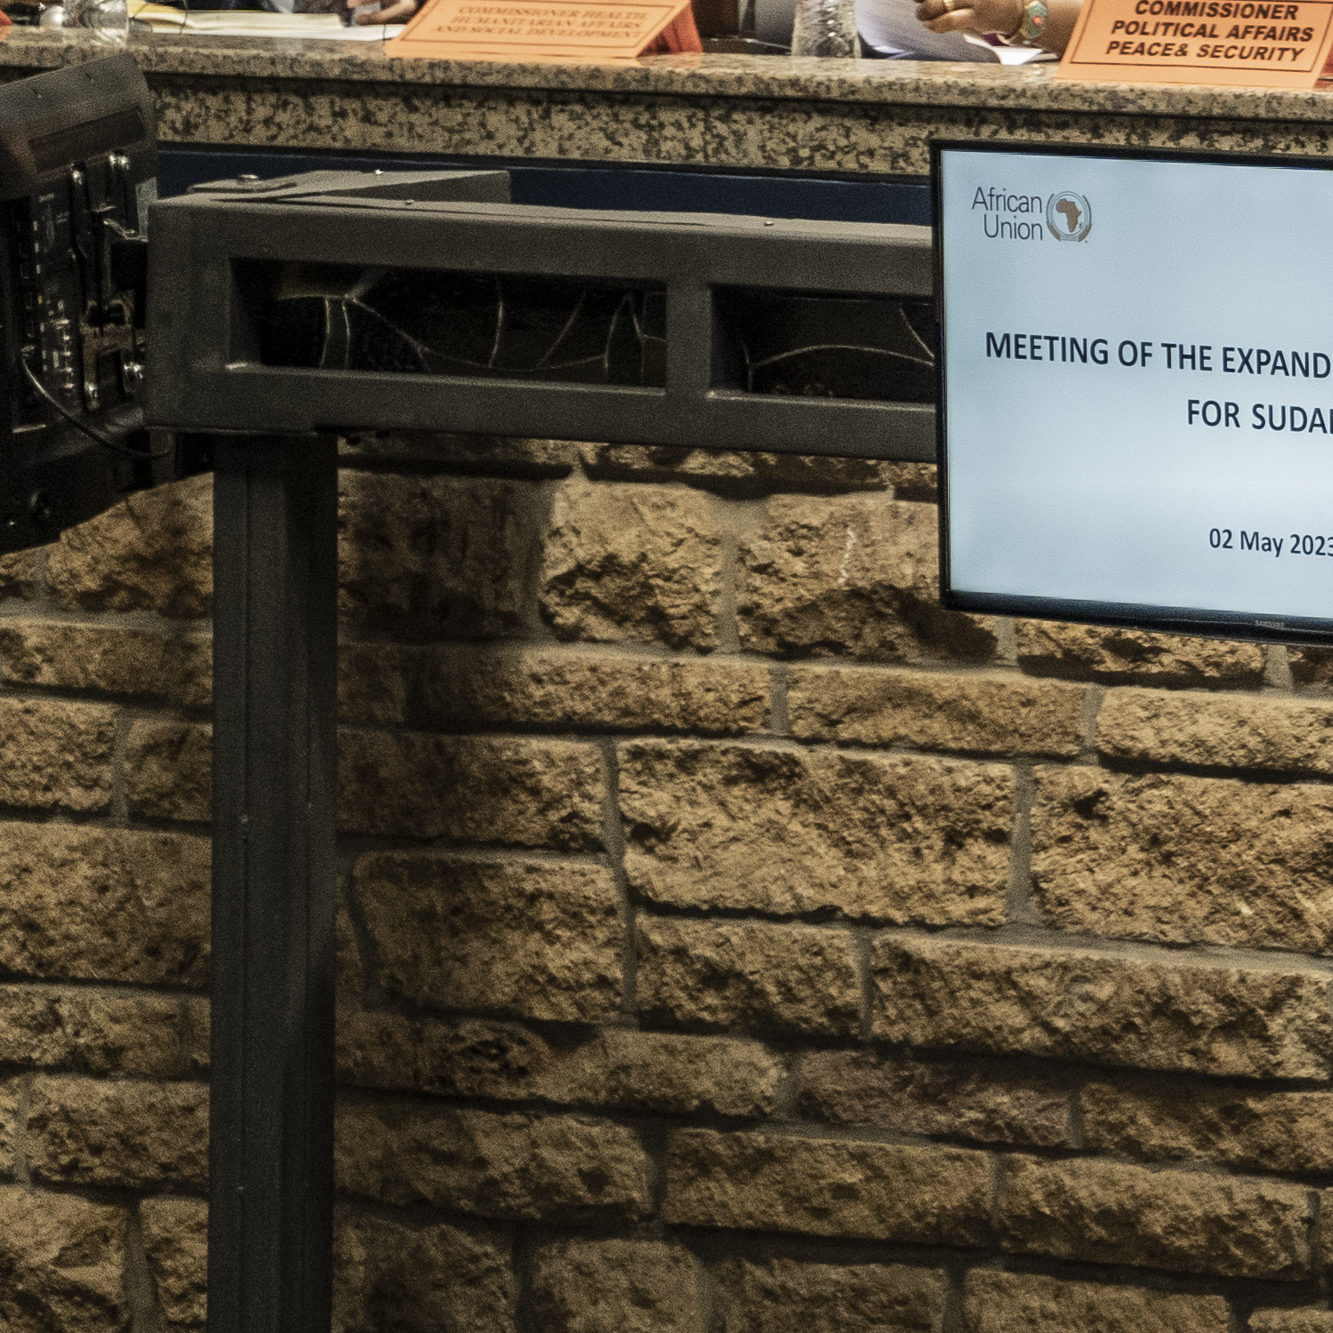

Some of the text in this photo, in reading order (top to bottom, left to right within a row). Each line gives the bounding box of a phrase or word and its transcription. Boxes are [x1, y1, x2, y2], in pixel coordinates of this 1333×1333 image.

[1134, 0, 1299, 21] COMMISSIONER
[1110, 19, 1314, 43] POLITICAL AFFAIRS
[1105, 40, 1305, 62] PEACE& SECURITY
[971, 186, 1043, 214] African
[983, 213, 1044, 241] Union
[985, 331, 1109, 365] MEETING
[1118, 339, 1153, 368] OF
[1160, 342, 1213, 372] THE
[1187, 399, 1241, 428] FOR
[1209, 527, 1234, 550] 02
[1240, 530, 1284, 558] May
